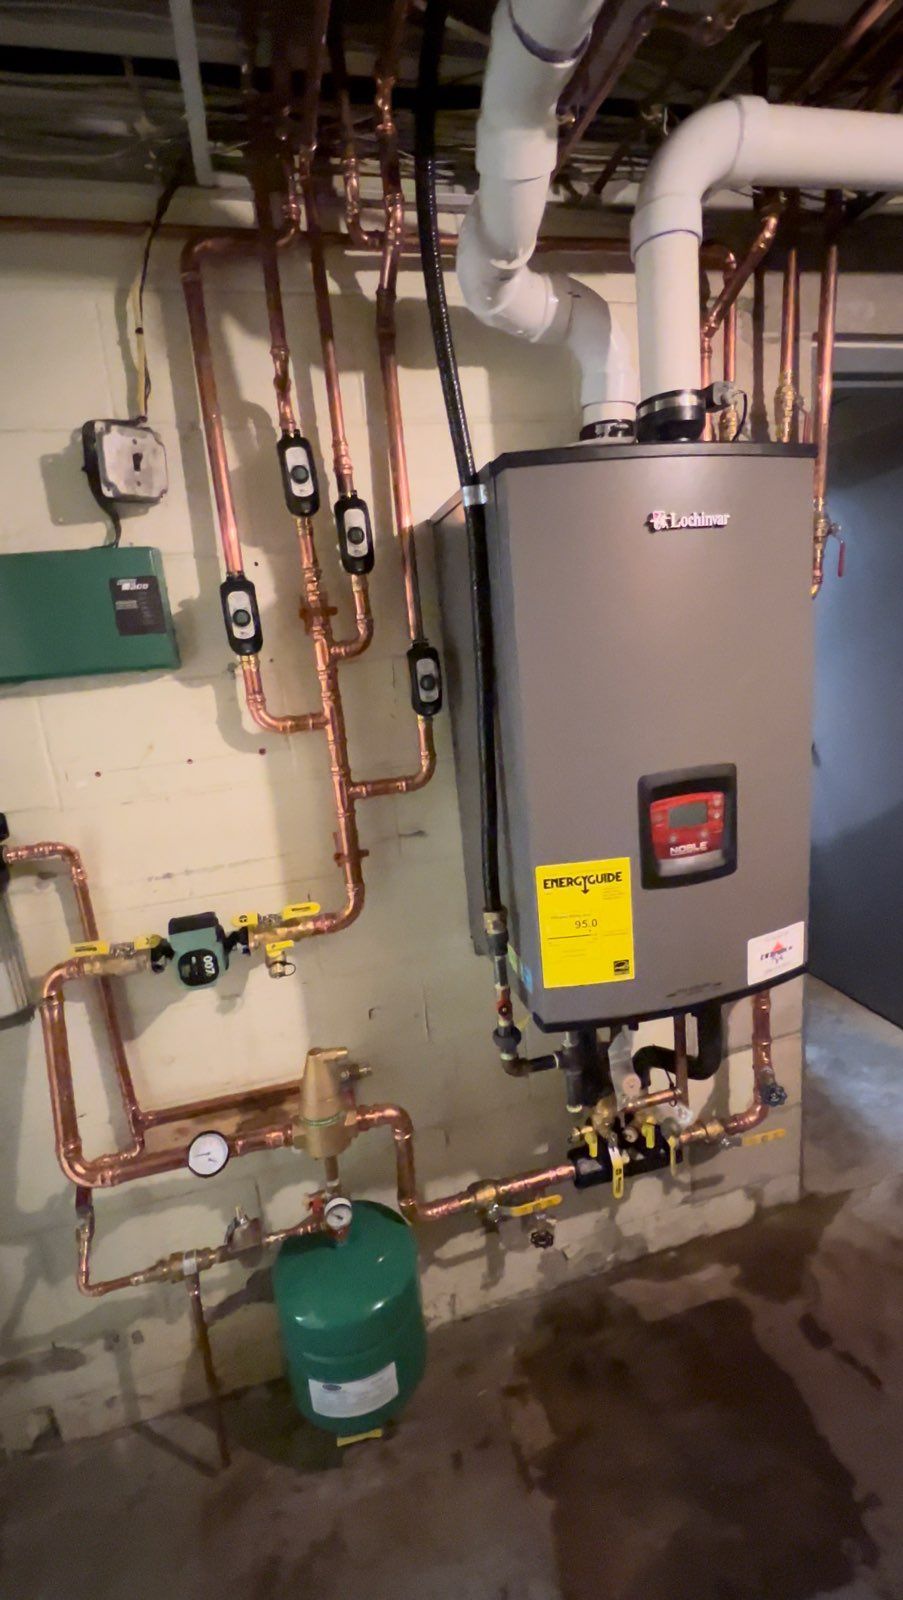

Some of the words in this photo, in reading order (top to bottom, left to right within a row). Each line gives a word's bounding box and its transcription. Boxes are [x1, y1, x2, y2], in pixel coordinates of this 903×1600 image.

[670, 511, 731, 528] Lochinvar
[669, 841, 709, 857] NOBLE
[543, 871, 623, 891] ENERGYGUIDE
[574, 918, 598, 930] 95.0
[203, 955, 215, 975] 007
